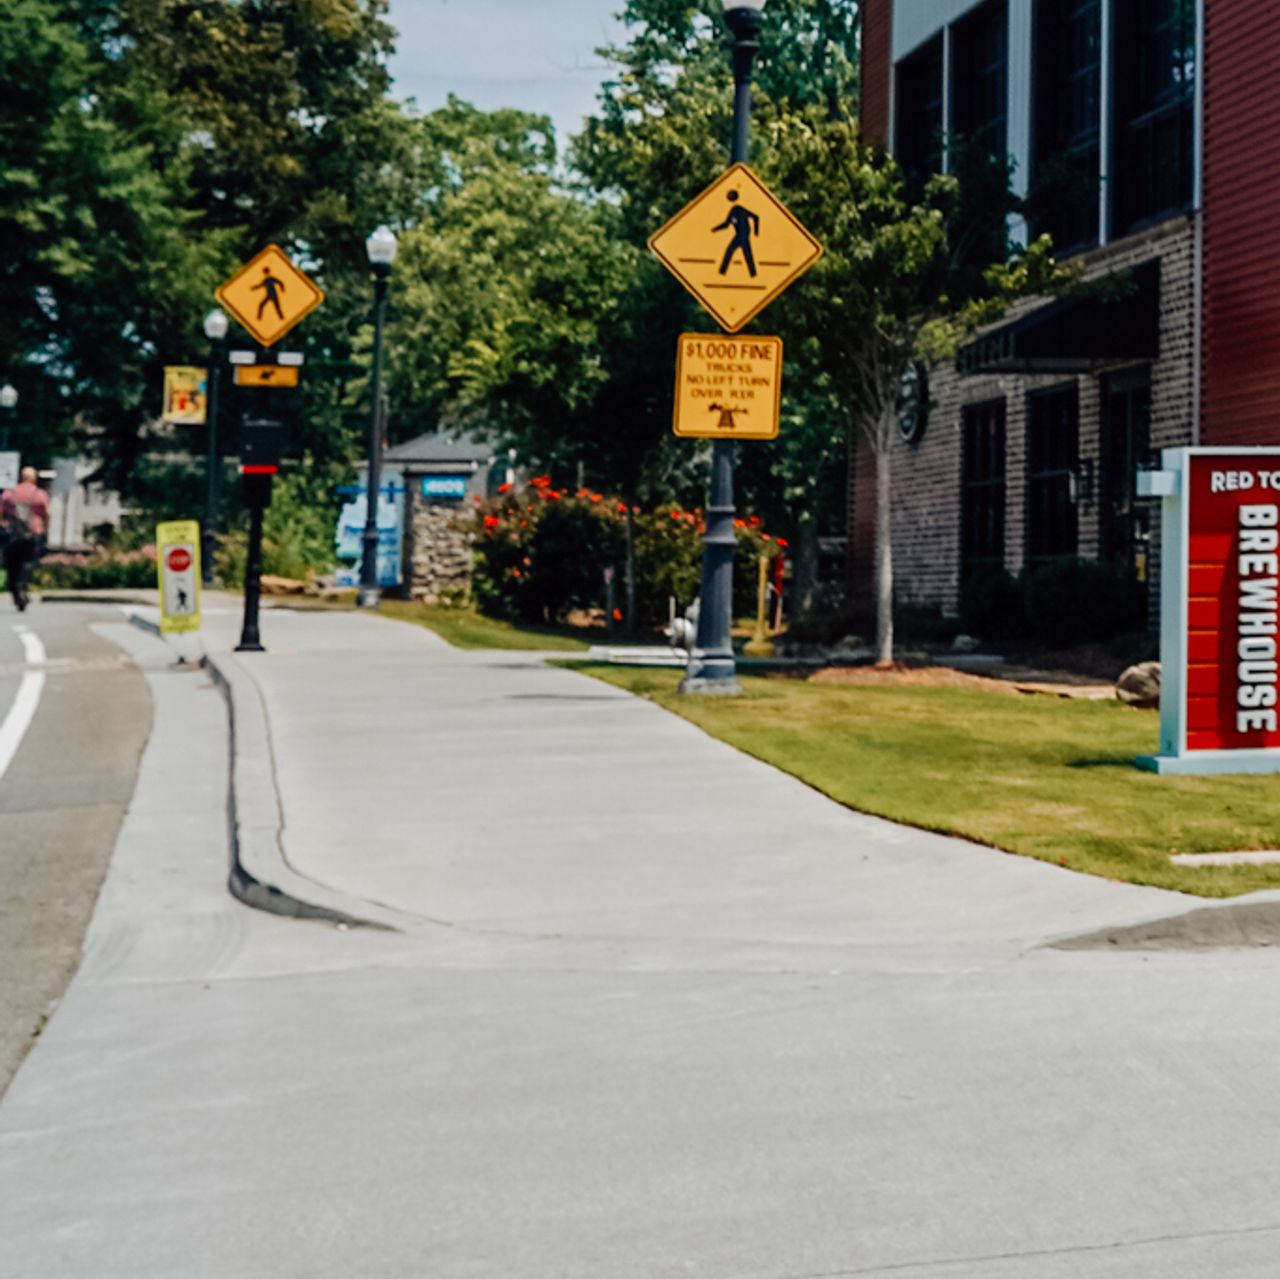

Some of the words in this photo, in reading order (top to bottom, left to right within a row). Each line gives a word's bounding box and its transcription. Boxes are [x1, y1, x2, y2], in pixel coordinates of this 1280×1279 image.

[686, 342, 737, 359] $1,000
[741, 343, 773, 361] FINE
[707, 362, 753, 373] TRUCKS
[686, 375, 705, 385] NO
[707, 375, 733, 386] LEFT
[739, 376, 770, 387] TURN
[690, 388, 723, 399] OVER
[1210, 471, 1254, 493] RED
[1236, 504, 1279, 733] BREWHOUSE
